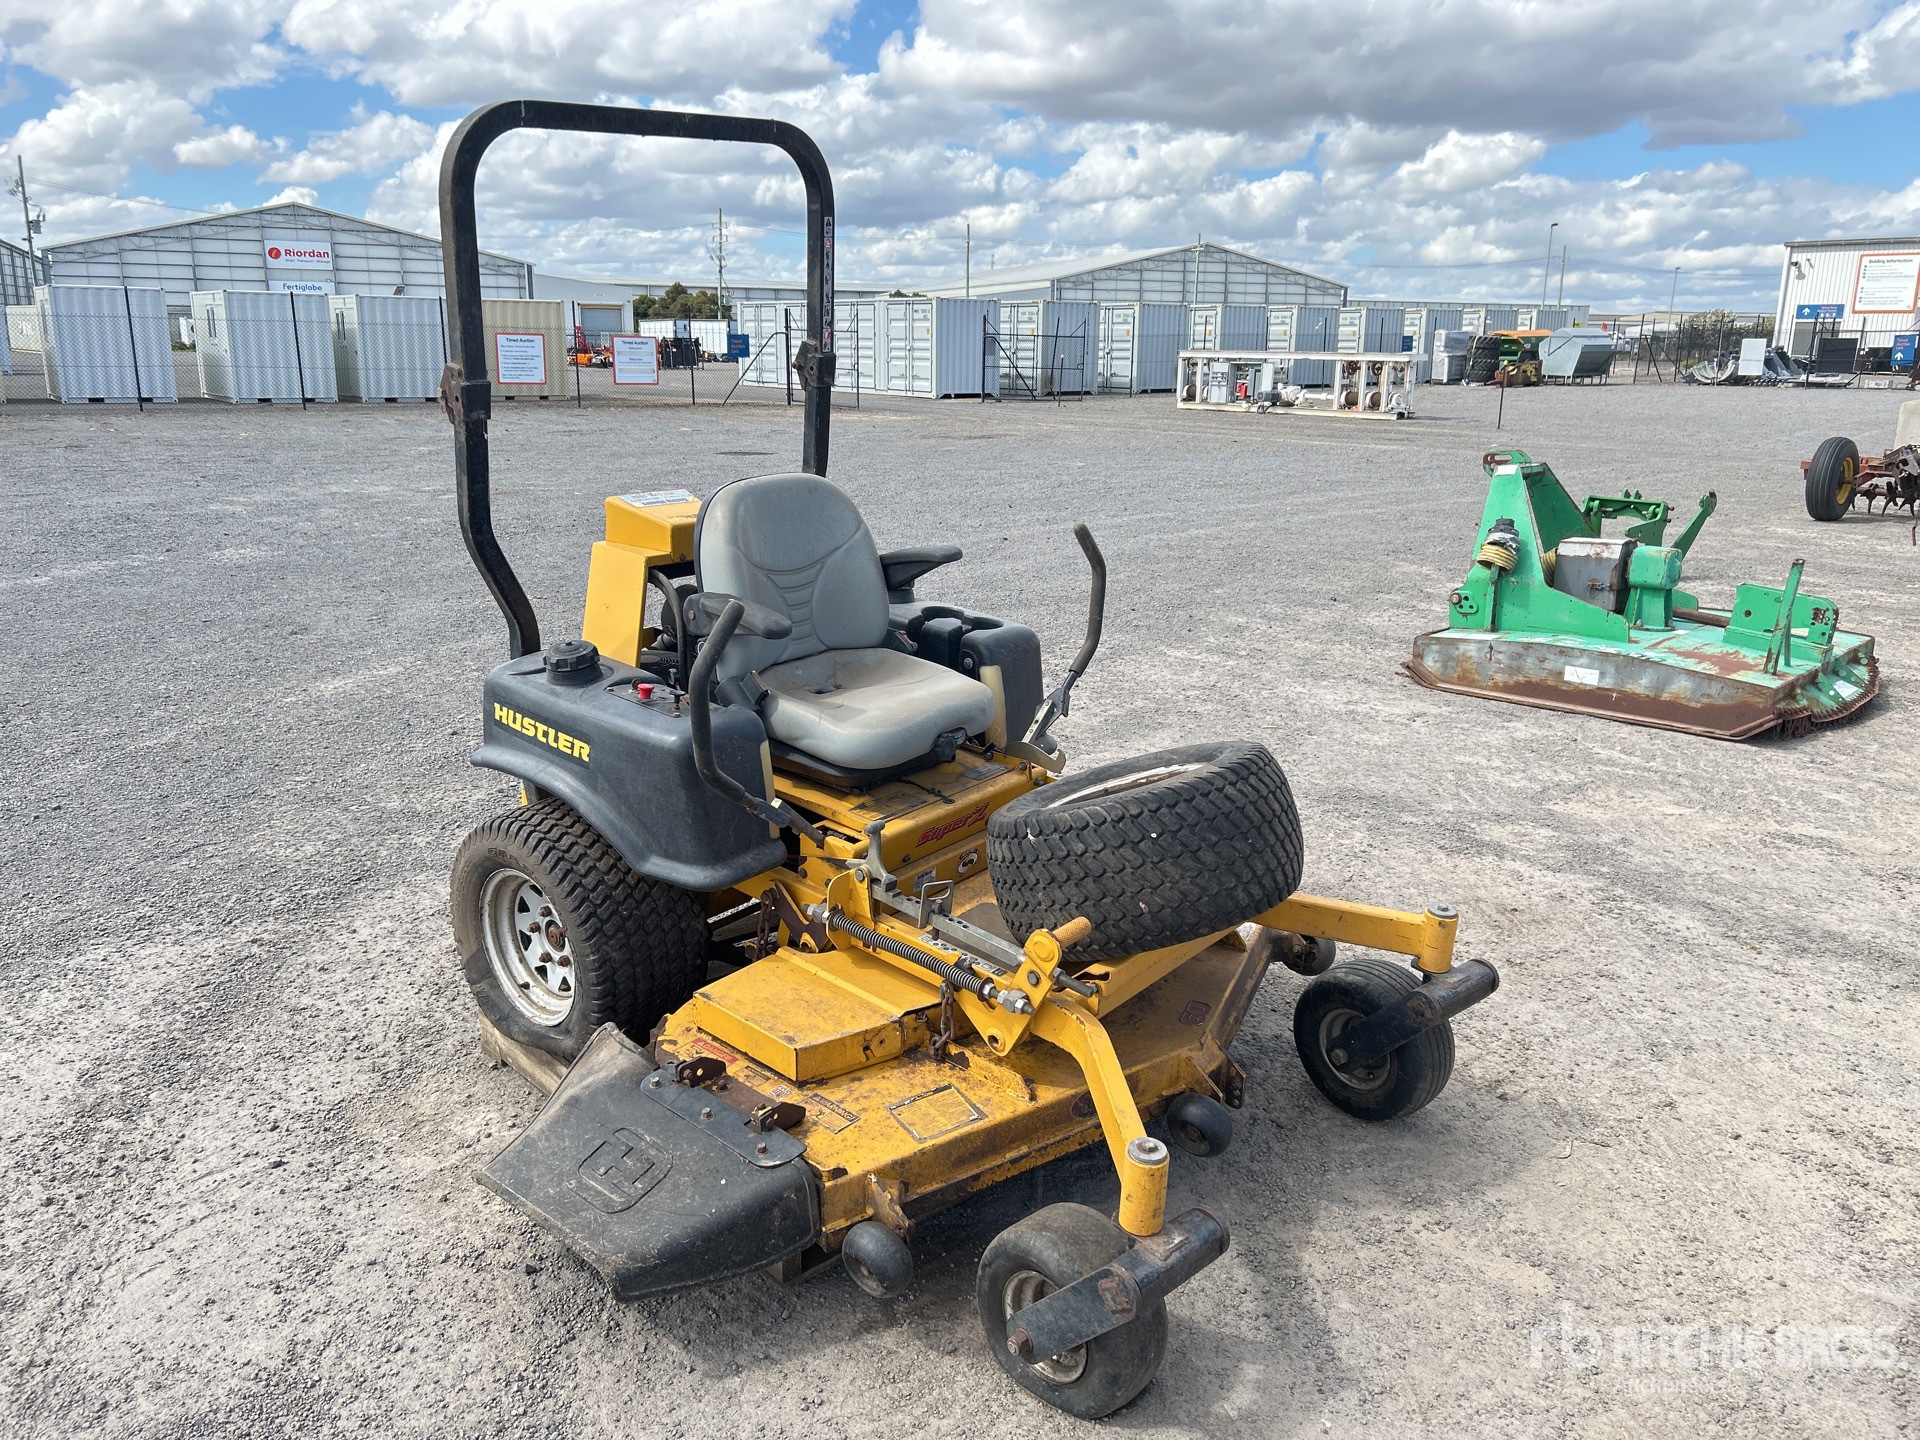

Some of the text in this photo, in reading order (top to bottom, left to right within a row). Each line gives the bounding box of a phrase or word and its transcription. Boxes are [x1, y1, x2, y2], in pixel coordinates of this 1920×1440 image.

[284, 248, 330, 259] Riordan
[282, 282, 322, 292] Fertiglobe
[493, 702, 590, 763] HUSTLER
